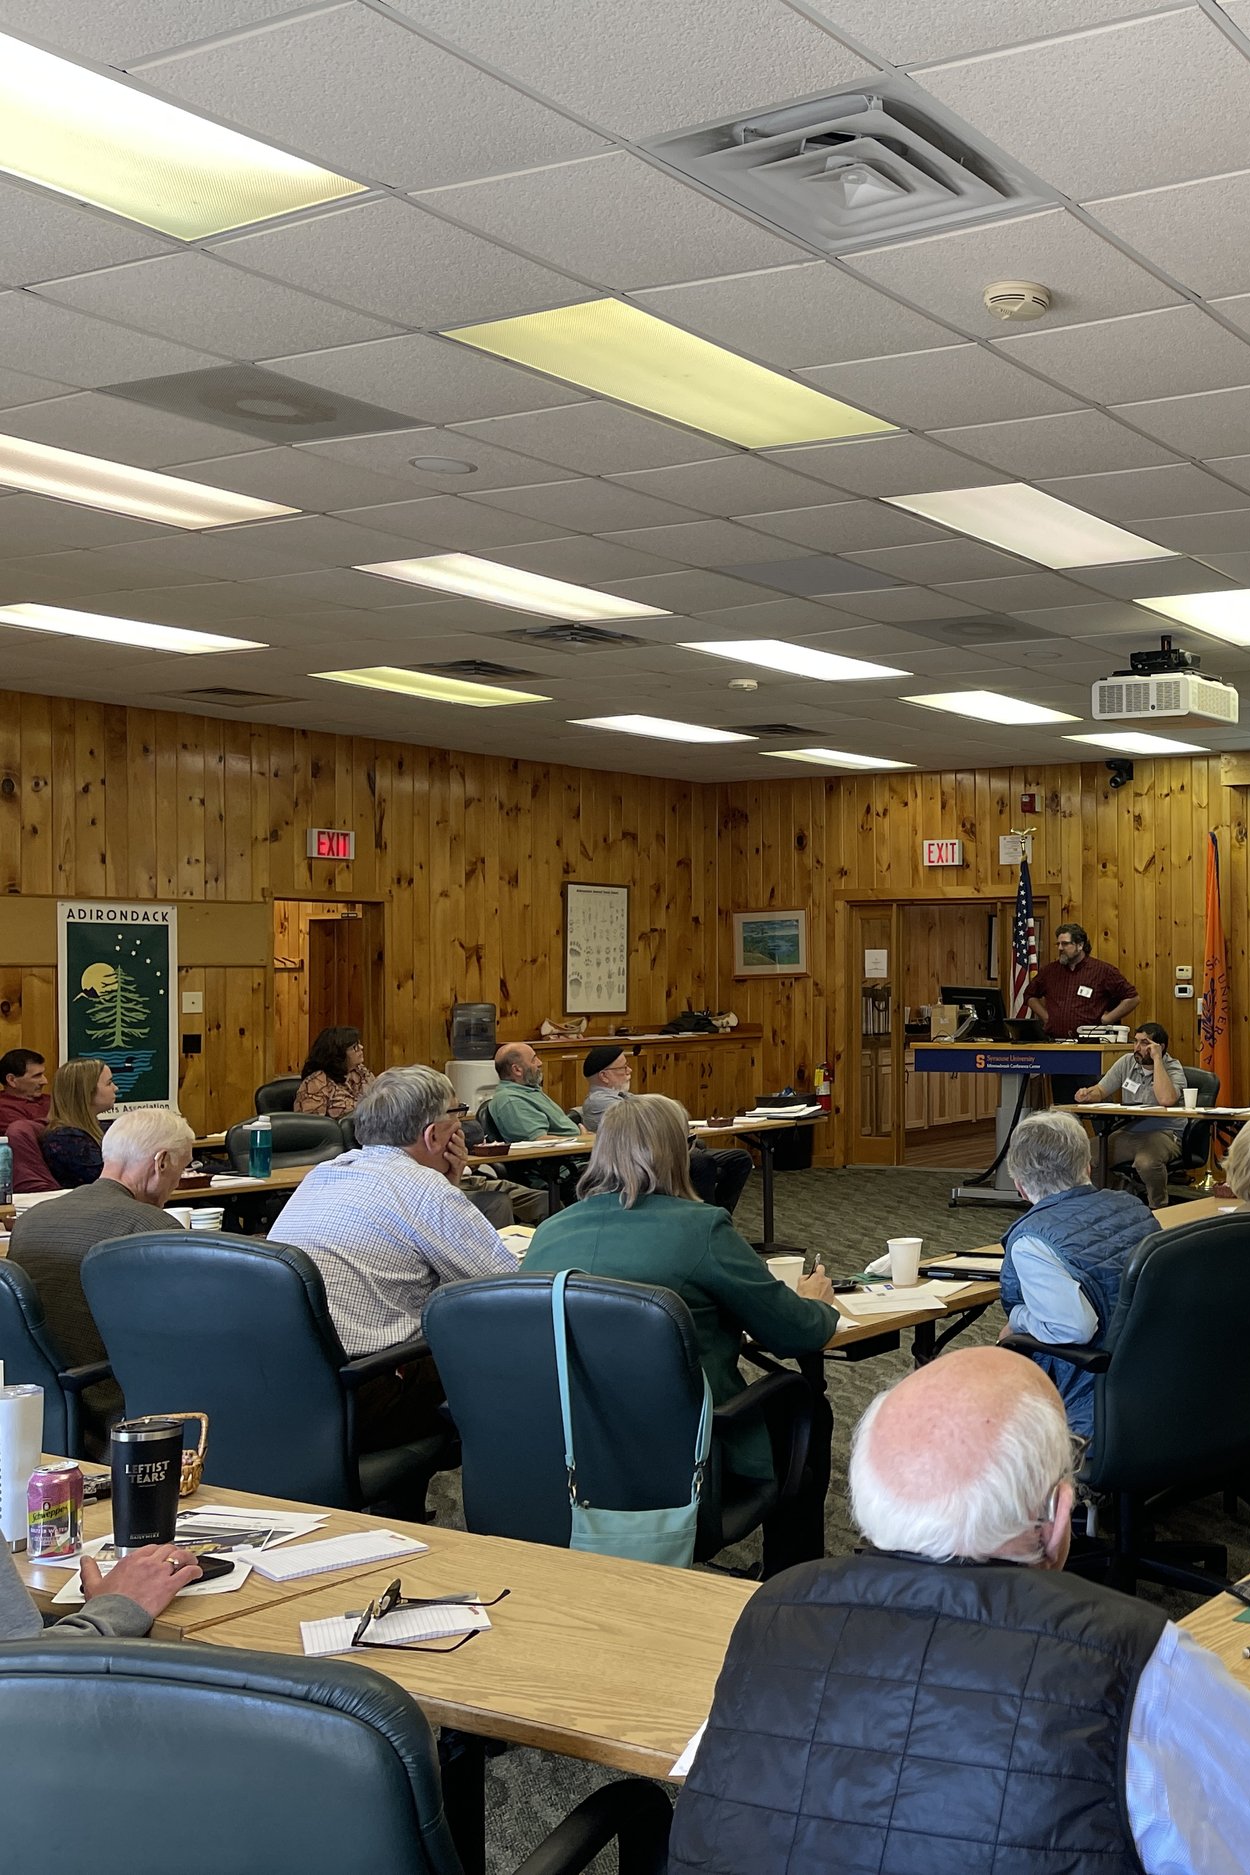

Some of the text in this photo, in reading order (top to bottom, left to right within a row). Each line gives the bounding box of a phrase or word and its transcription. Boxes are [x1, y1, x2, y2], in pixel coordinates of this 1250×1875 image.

[317, 830, 349, 857] EXIT
[927, 843, 957, 864] EXIT
[66, 908, 169, 923] ADIRONDACK
[1010, 1054, 1035, 1063] University
[125, 1460, 170, 1474] LEFTIST
[128, 1471, 166, 1484] TEARS
